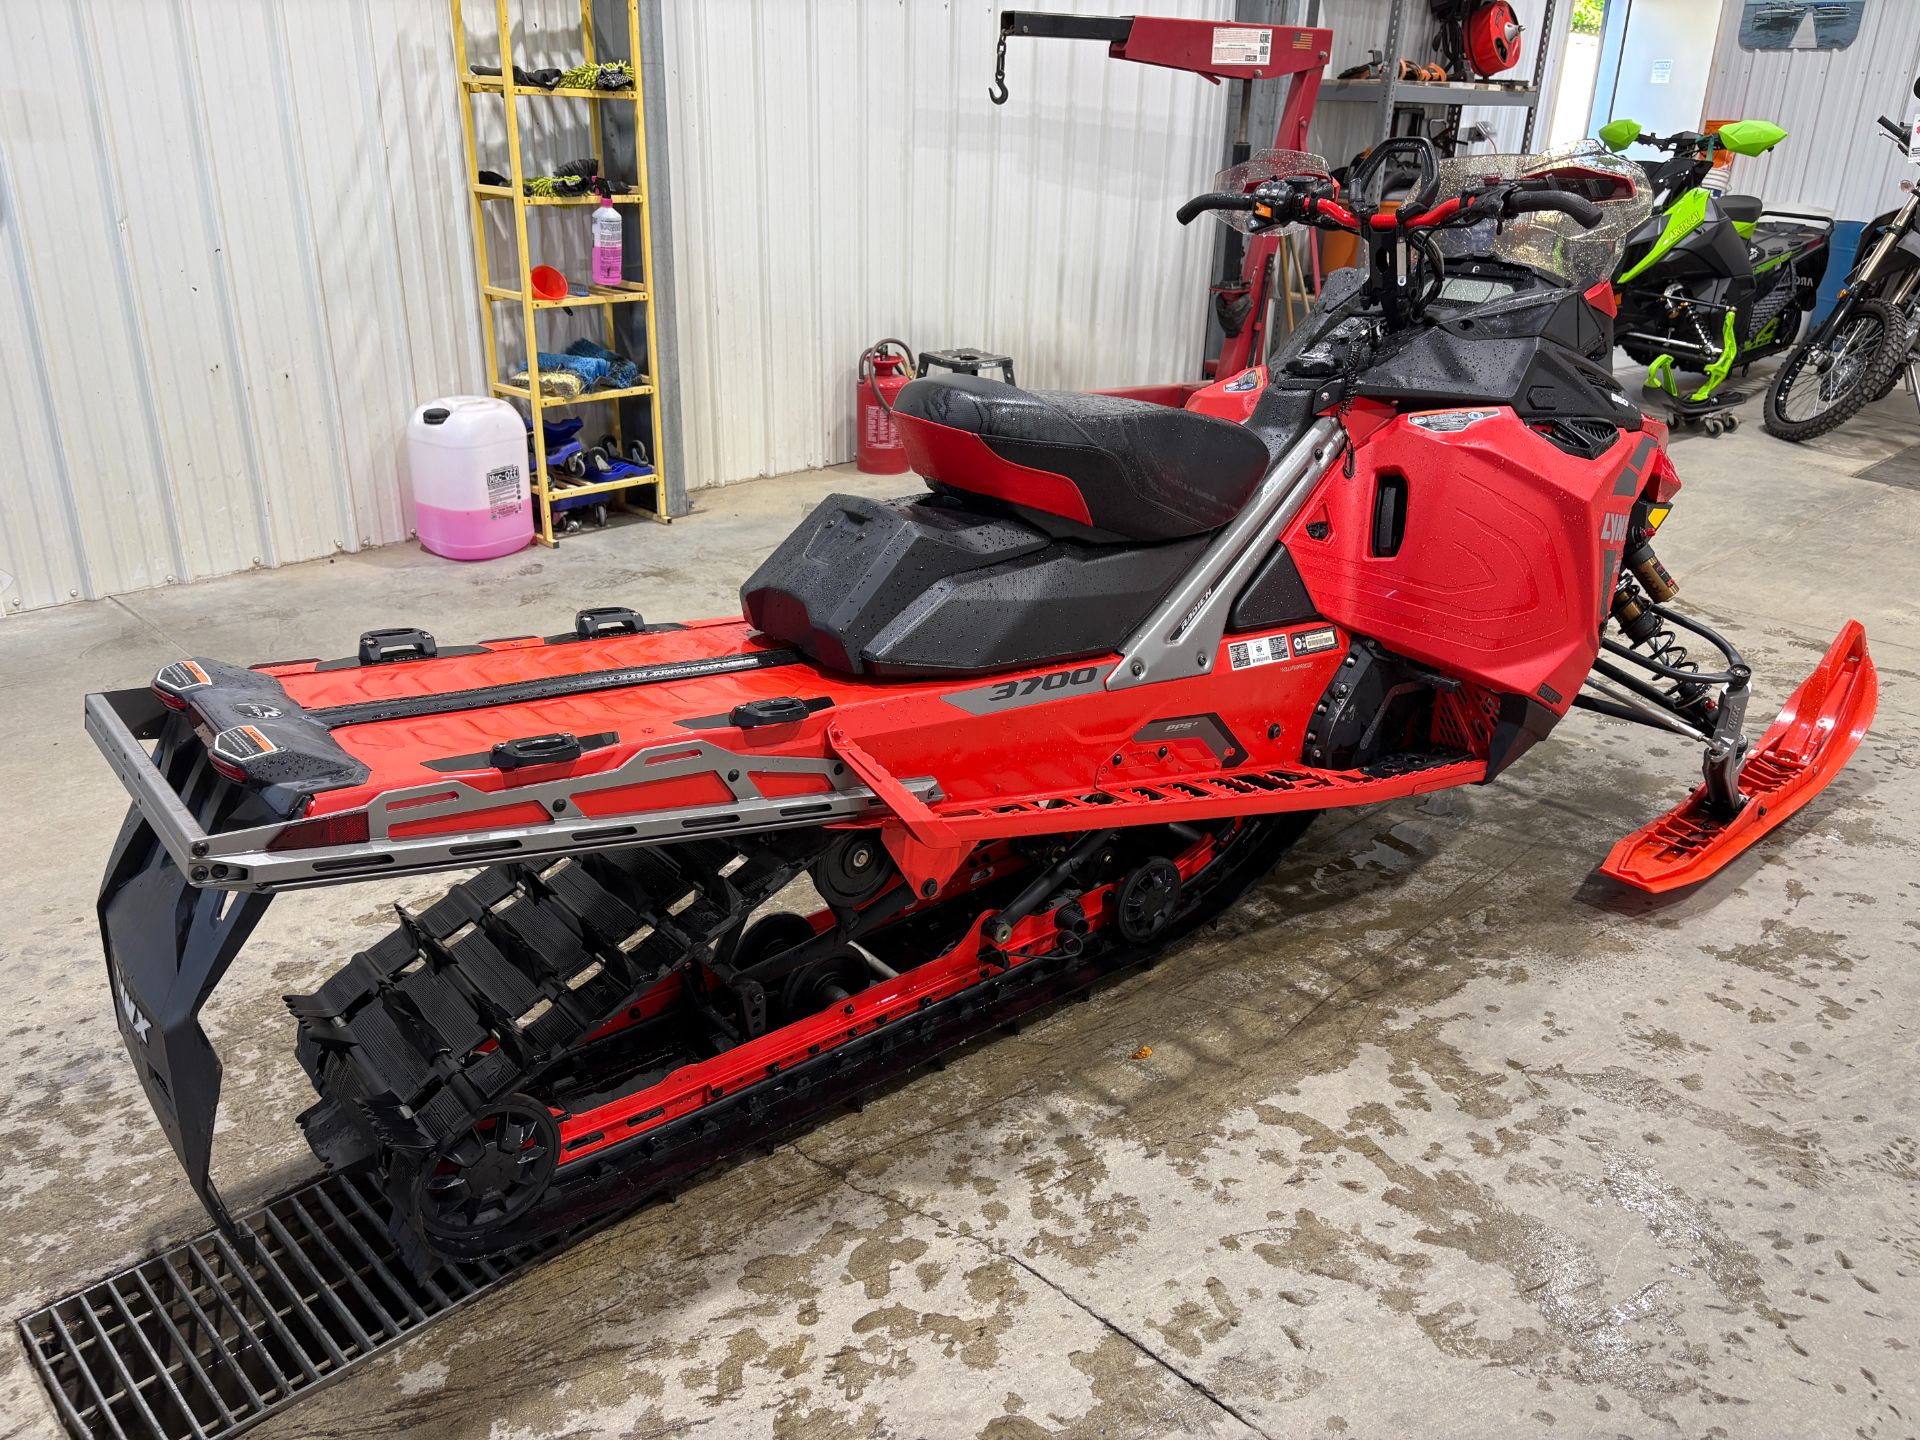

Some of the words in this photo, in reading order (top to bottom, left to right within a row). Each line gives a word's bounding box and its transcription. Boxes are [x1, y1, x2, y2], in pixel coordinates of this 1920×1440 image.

[1669, 218, 1691, 241] ARCTIC
[488, 468, 519, 486] Muc-Off
[1601, 512, 1630, 544] LYN
[988, 667, 1098, 701] 3700
